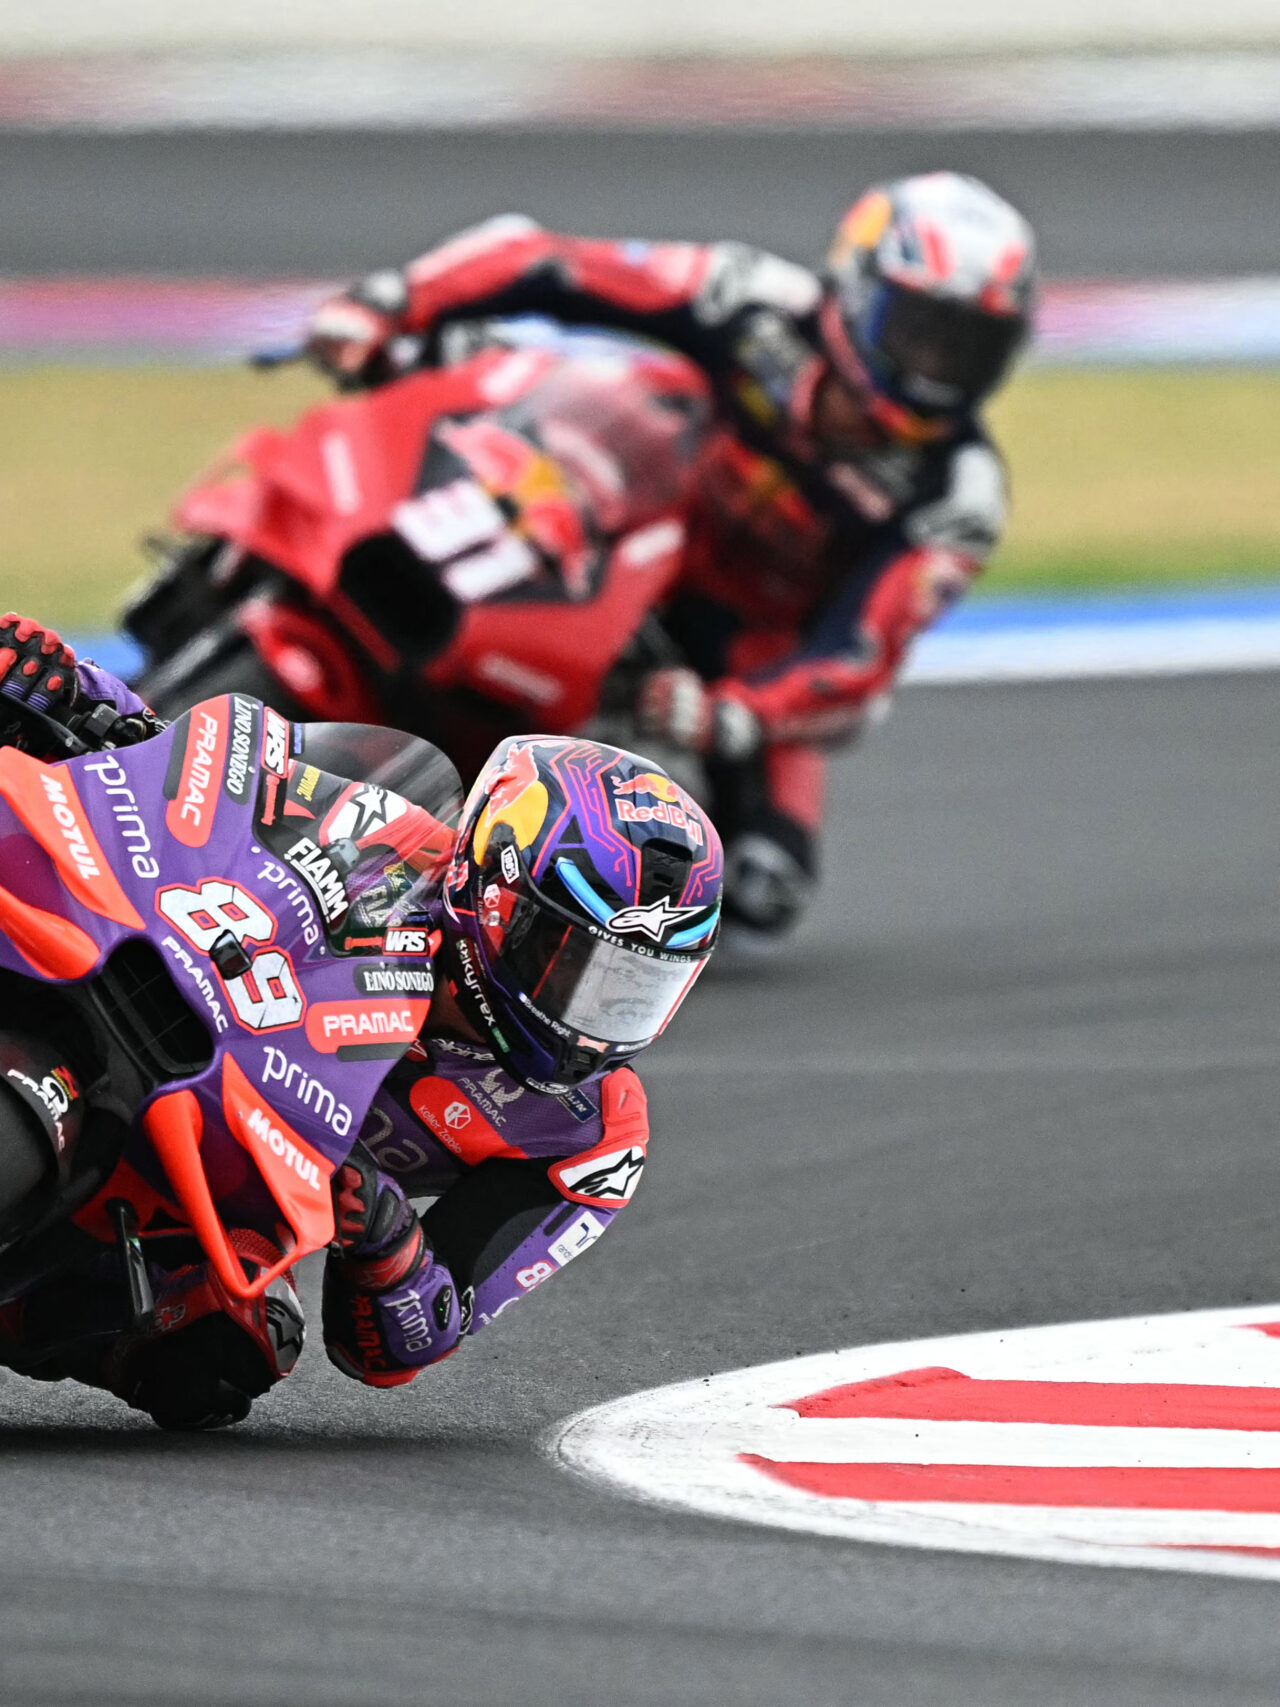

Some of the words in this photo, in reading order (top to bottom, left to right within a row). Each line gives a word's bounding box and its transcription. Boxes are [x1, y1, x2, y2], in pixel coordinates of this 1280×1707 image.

[181, 712, 218, 826] PRAMAC
[265, 711, 286, 775] WRS
[40, 774, 100, 880] MOTUL
[84, 755, 160, 878] prima
[615, 799, 670, 824] Red
[258, 861, 319, 945] prima
[287, 837, 349, 920] FIAMM
[157, 878, 306, 1033] 89
[385, 931, 426, 952] WRS
[588, 926, 624, 946] GIVES
[631, 943, 654, 956] YOU
[660, 952, 691, 962] WINGS
[161, 936, 228, 1033] PRAMAC
[323, 1011, 413, 1037] PRAMAC
[263, 1046, 352, 1136] prima
[457, 1077, 507, 1127] PRAMAC
[249, 1109, 320, 1190] MOTUL
[384, 1289, 432, 1352] prima
